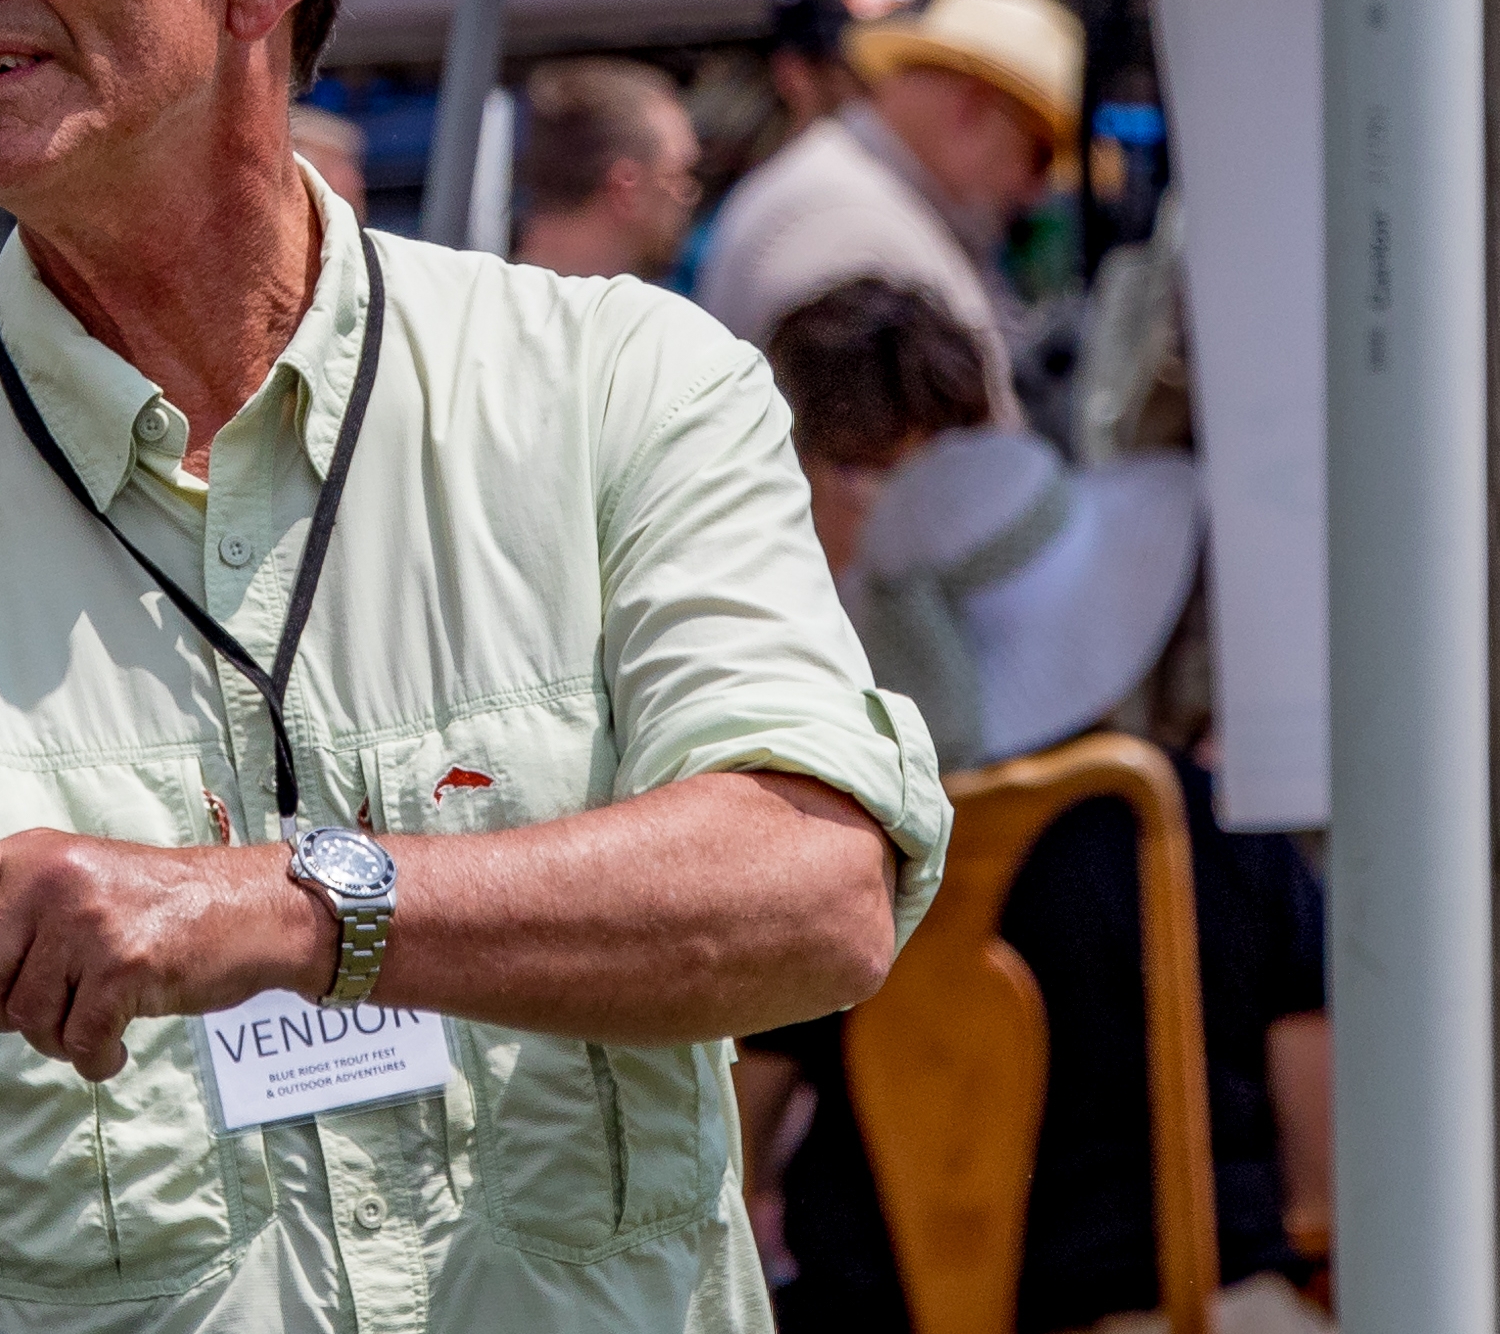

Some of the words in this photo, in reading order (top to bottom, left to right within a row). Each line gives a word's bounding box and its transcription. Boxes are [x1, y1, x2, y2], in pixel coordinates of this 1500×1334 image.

[266, 1088, 274, 1099] &
[277, 1075, 333, 1097] OUTDOOR
[335, 1060, 407, 1084] ADVENTURES
[268, 1069, 296, 1083] BLUE
[298, 1061, 331, 1077] RIDGE
[334, 1053, 370, 1069] TROUT
[372, 1046, 396, 1061] FEST
